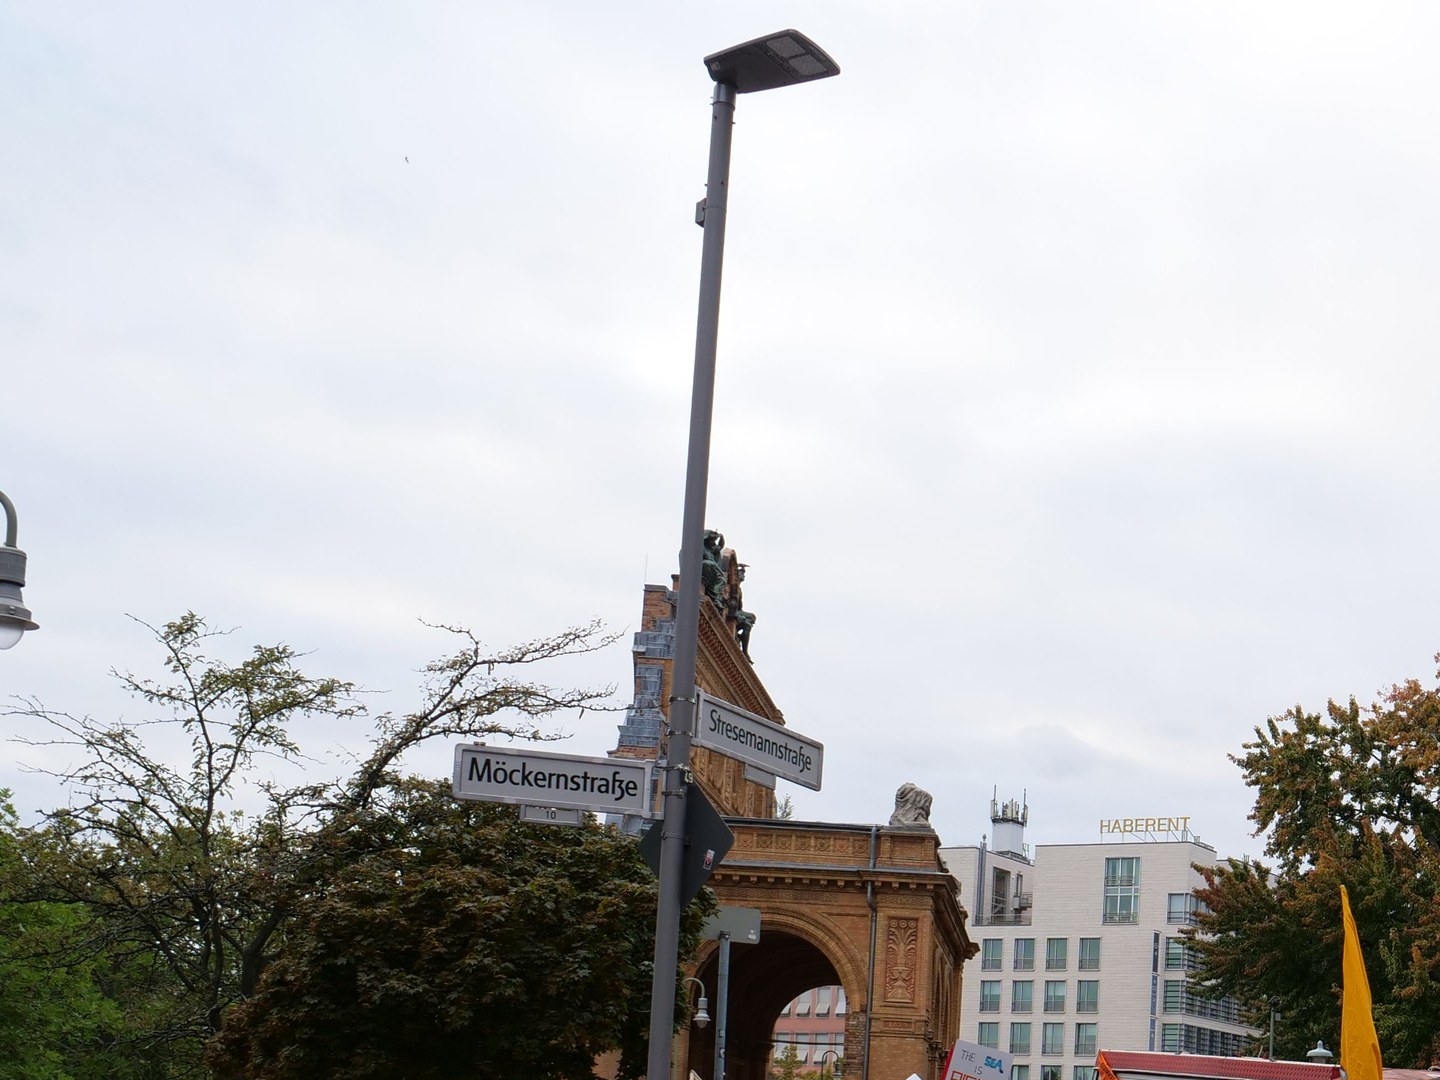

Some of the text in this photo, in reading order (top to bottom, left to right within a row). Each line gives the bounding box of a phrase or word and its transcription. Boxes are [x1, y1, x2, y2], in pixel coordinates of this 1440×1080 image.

[709, 709, 812, 773] Stresemannstraße
[468, 757, 638, 801] Möckernstraße
[545, 810, 557, 820] 10
[1100, 816, 1191, 833] HABERENT
[960, 1049, 1004, 1074] THE SEA
[974, 1065, 983, 1075] IS
